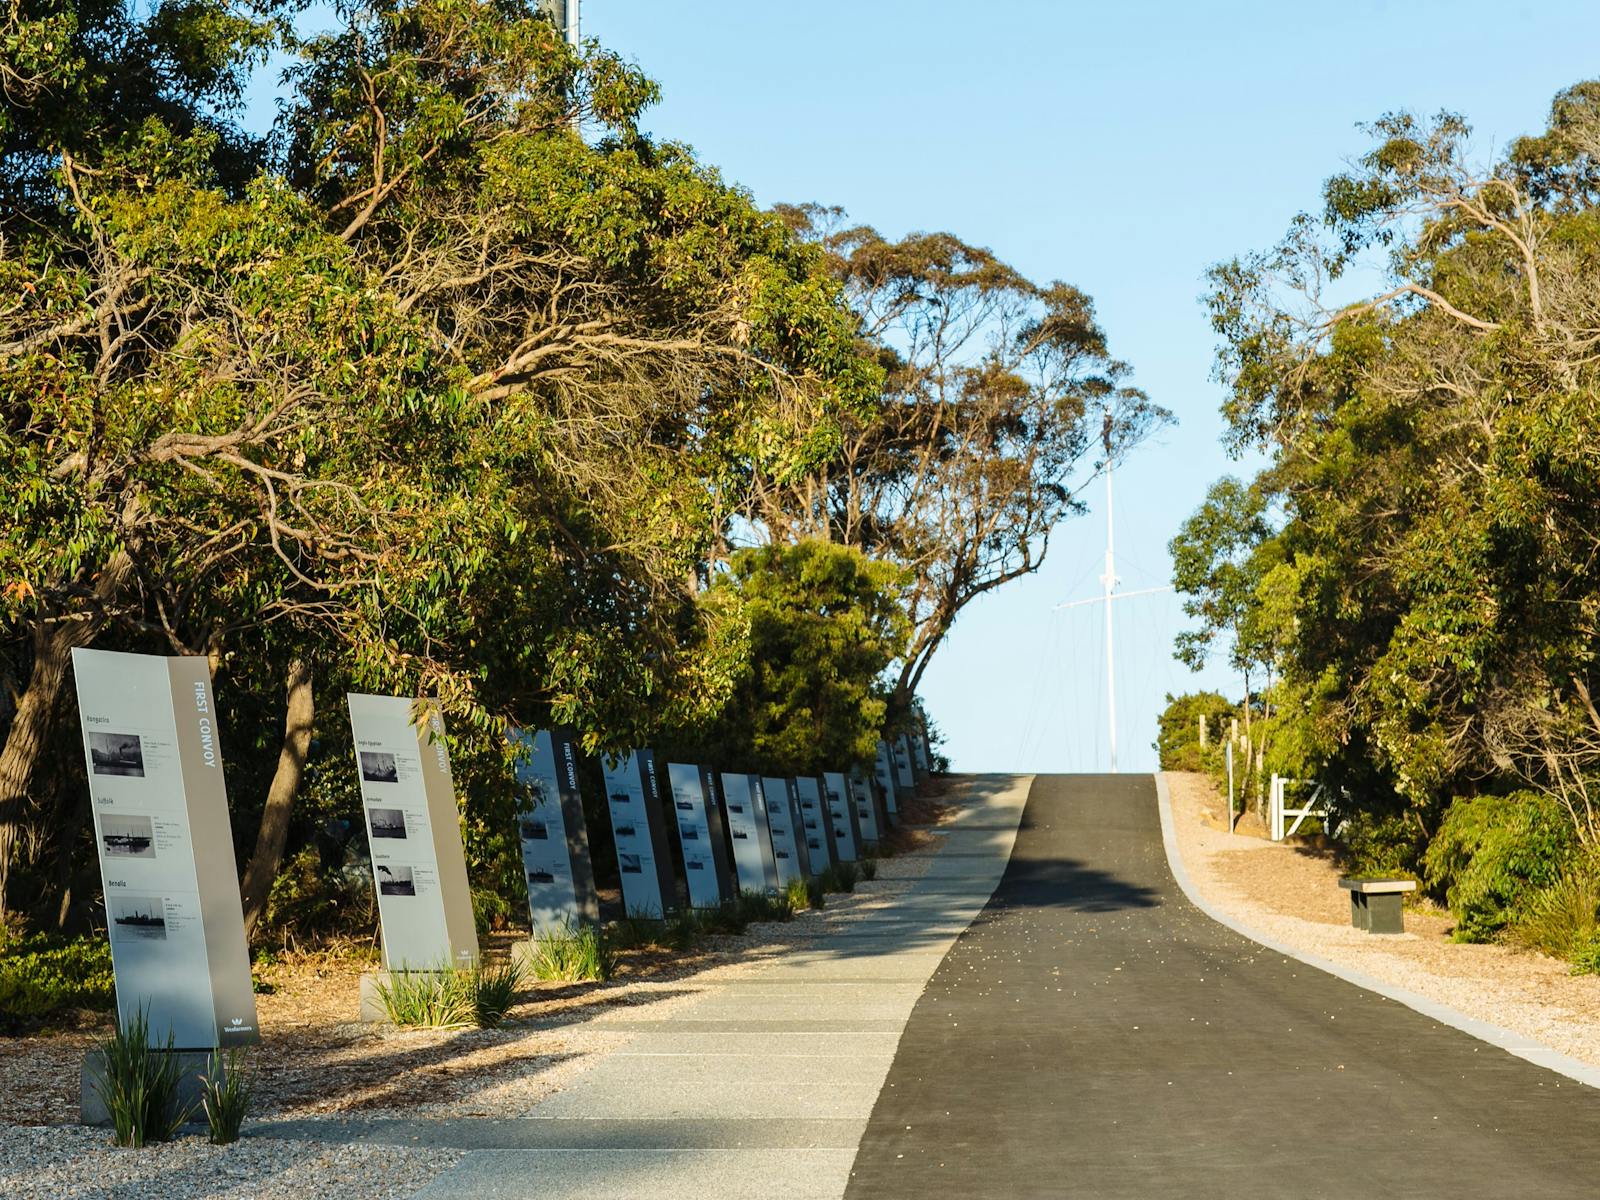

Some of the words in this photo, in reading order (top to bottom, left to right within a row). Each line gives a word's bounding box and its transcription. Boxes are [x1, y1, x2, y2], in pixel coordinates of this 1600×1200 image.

[194, 681, 208, 714] FIRST
[199, 718, 216, 769] CONVOY
[563, 742, 572, 761] FIRST
[437, 743, 448, 774] ONVOY
[647, 759, 655, 775] FIRST
[566, 762, 577, 790] CONVOY
